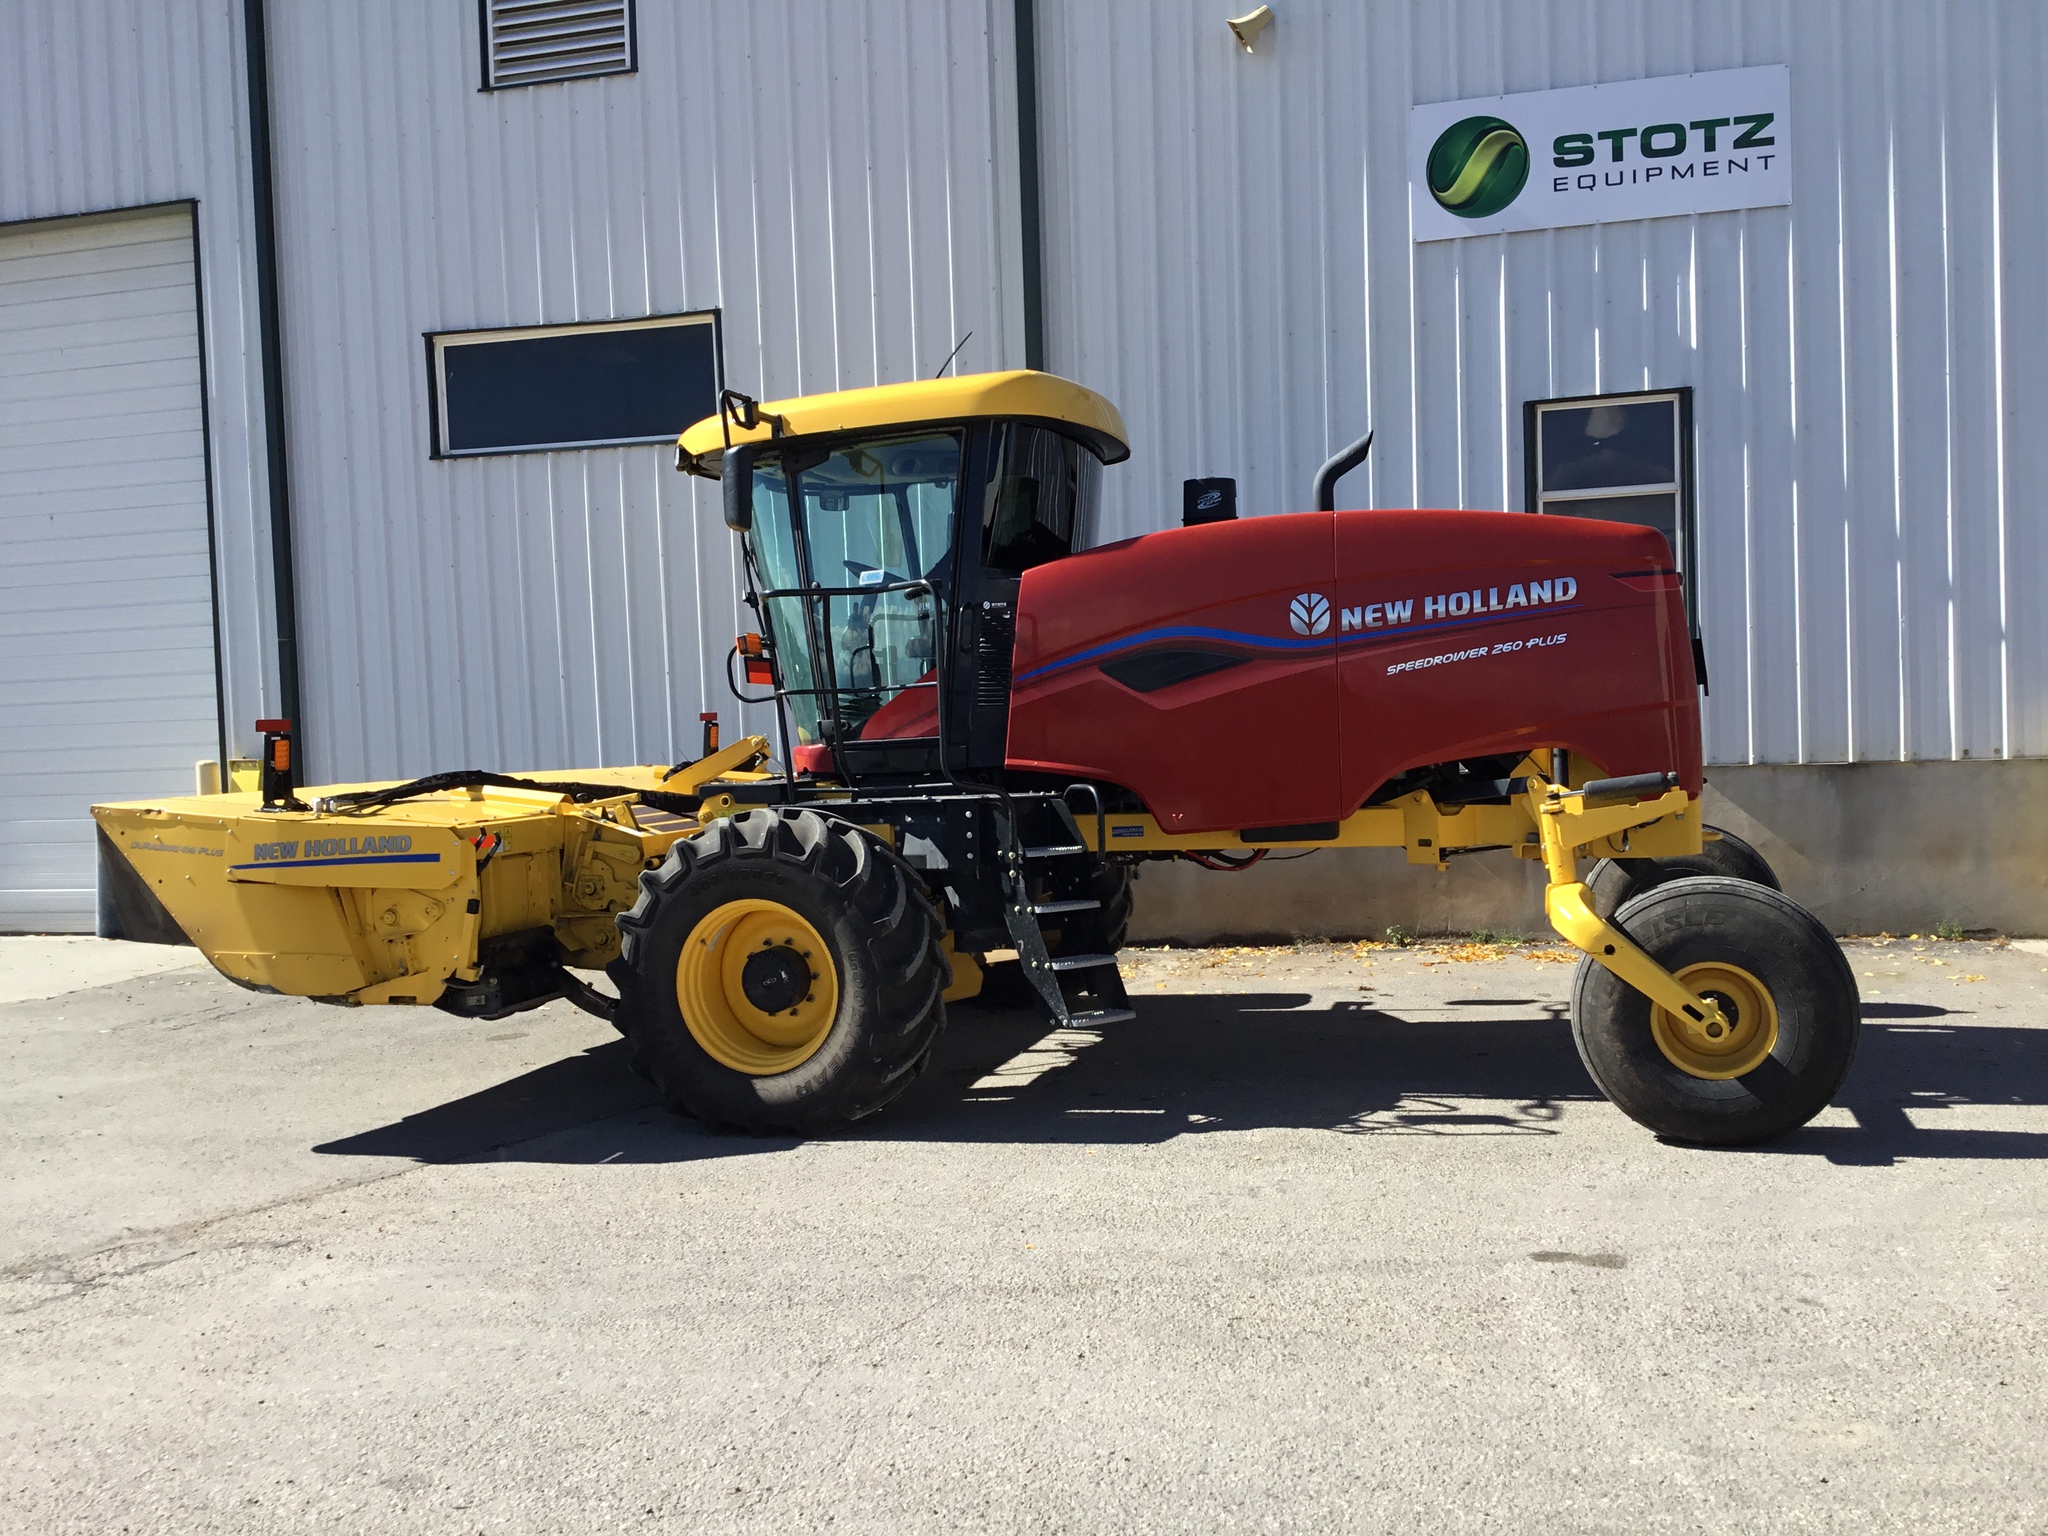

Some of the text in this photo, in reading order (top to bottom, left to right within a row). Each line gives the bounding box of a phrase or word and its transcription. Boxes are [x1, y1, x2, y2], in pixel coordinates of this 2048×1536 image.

[1553, 112, 1775, 168] STOTZ
[1553, 154, 1776, 193] EQUIPMENT
[1340, 576, 1578, 632] NEW HOLLAND
[1386, 633, 1568, 676] SPEEDROWER 260 PLUS
[197, 847, 225, 857] PLUS
[253, 835, 413, 861] NEW HOLLAND
[795, 951, 866, 1098] GOODYEAR
